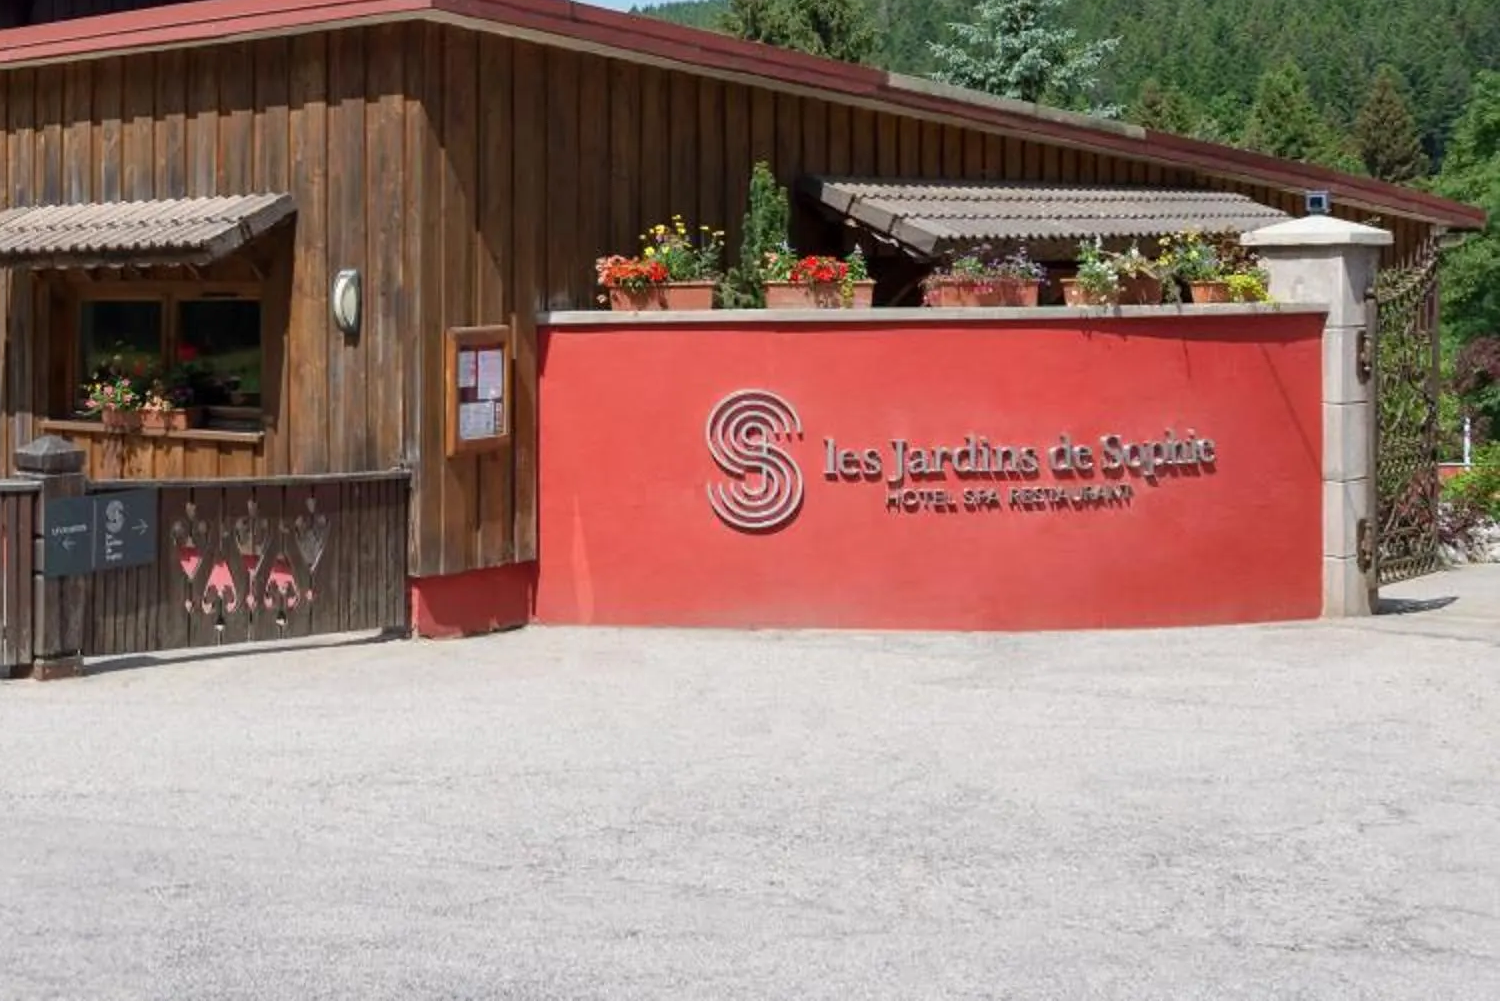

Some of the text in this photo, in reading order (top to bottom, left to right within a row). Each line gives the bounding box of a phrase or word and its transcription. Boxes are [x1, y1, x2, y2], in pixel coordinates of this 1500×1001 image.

[823, 428, 1217, 484] les Jardins de Sophie
[963, 486, 1000, 505] SPA
